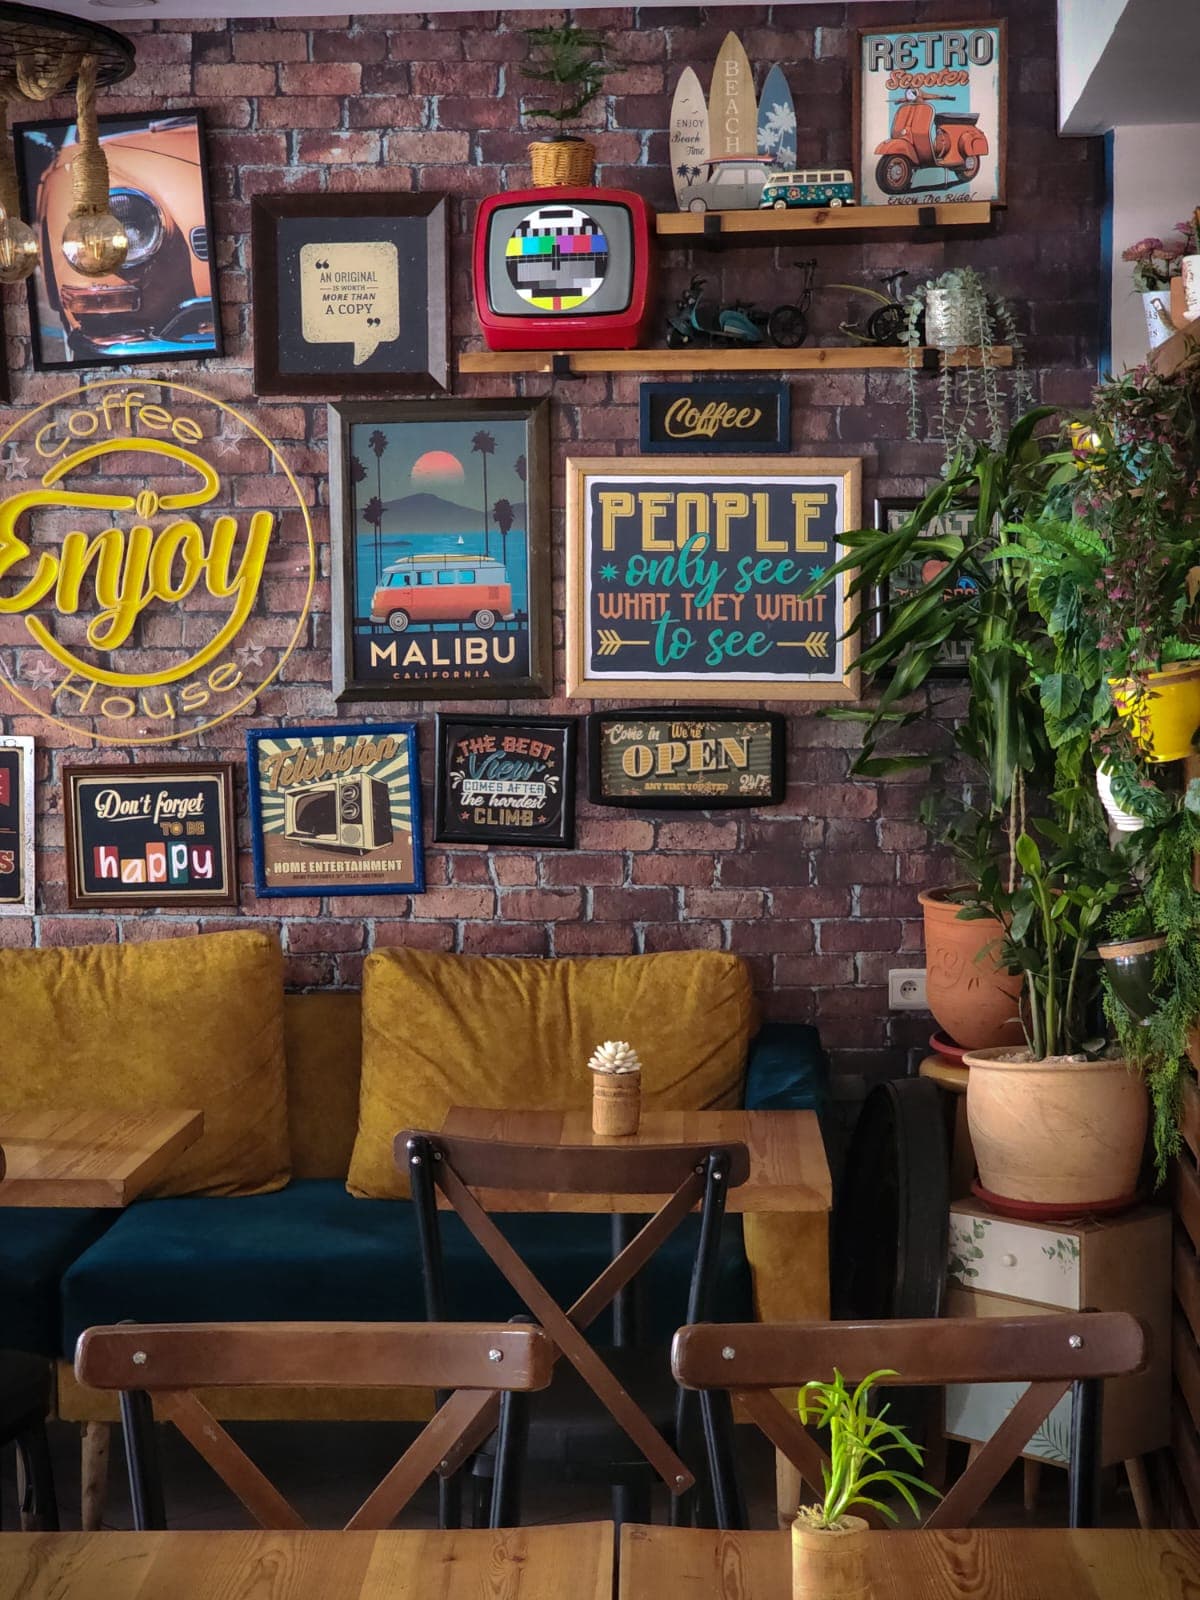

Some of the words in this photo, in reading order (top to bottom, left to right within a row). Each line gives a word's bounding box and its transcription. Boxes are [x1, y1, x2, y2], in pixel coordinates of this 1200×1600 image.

[869, 30, 993, 71] RETRO
[886, 68, 969, 90] Scooter
[725, 61, 740, 153] BEACH
[671, 131, 701, 143] Beach
[687, 146, 705, 155] Time
[320, 272, 331, 283] AN
[335, 271, 377, 283] ORIGINAL
[326, 305, 334, 315] A
[338, 304, 373, 315] COPY
[664, 397, 762, 438] Coffee
[598, 492, 828, 552] PEOPLE
[624, 532, 727, 608] only
[734, 556, 802, 593] see
[0, 490, 274, 687] Enjoy
[598, 593, 670, 620] WHAT
[681, 593, 744, 621] THEY
[755, 594, 827, 621] WANT
[370, 637, 515, 667] MALIBU
[651, 610, 697, 666] to
[705, 628, 774, 666] see
[393, 670, 490, 680] CALIFORNIA
[52, 662, 243, 720] House
[457, 736, 496, 756] THE
[501, 736, 555, 760] BEST
[605, 724, 643, 744] Come
[648, 727, 660, 740] in
[262, 737, 398, 791] Television
[469, 750, 546, 780] View
[622, 736, 751, 778] OPEN
[461, 792, 485, 805] the
[489, 793, 547, 809] hardest
[464, 781, 503, 792] COMES
[507, 783, 545, 794] AFTER
[95, 789, 152, 819] Don't
[153, 790, 204, 824] forget
[474, 808, 534, 826] CLIMB
[160, 821, 183, 836] TO
[186, 821, 205, 836] BE
[98, 843, 214, 884] happy
[273, 862, 306, 874] HOME
[308, 859, 402, 873] ENTERTAINMENT
